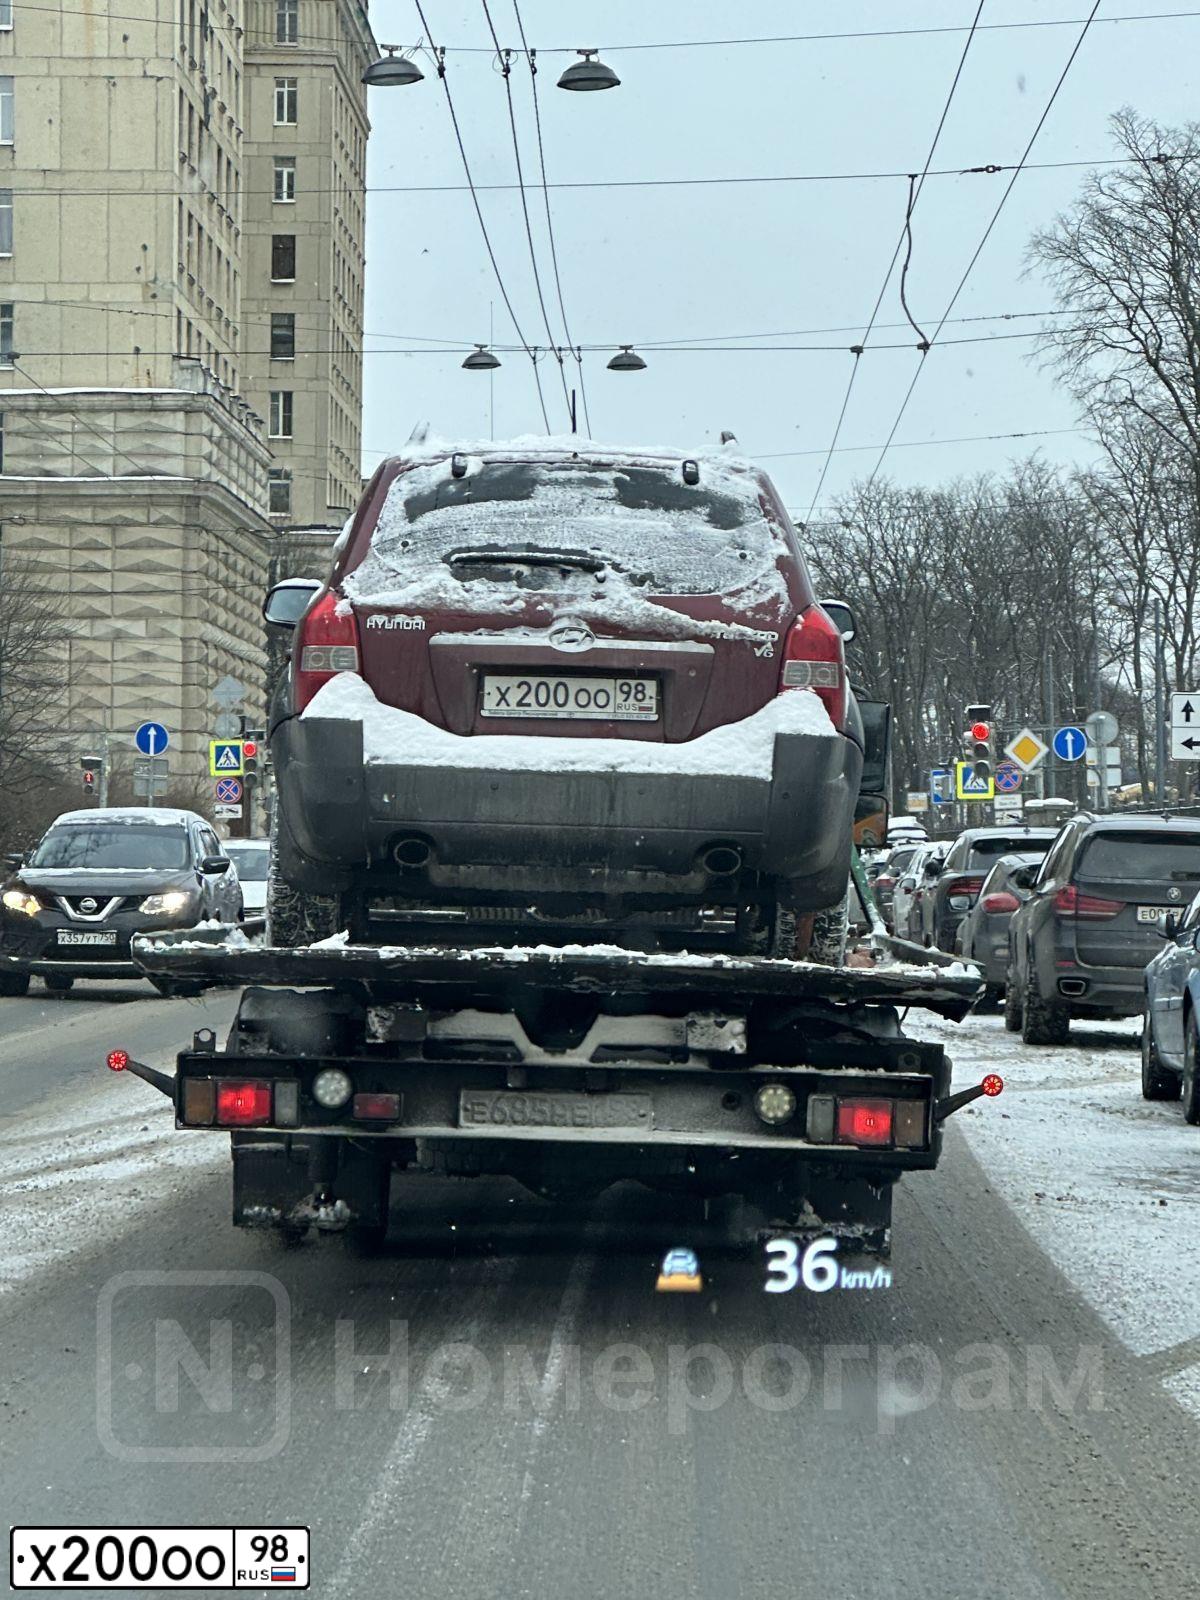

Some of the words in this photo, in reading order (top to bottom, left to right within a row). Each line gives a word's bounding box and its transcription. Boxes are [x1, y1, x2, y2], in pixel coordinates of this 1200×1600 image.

[366, 616, 425, 630] HYUNDAI
[619, 682, 646, 702] 98
[617, 703, 637, 712] RUS
[764, 1238, 839, 1293] 36
[841, 1266, 891, 1289] km/h
